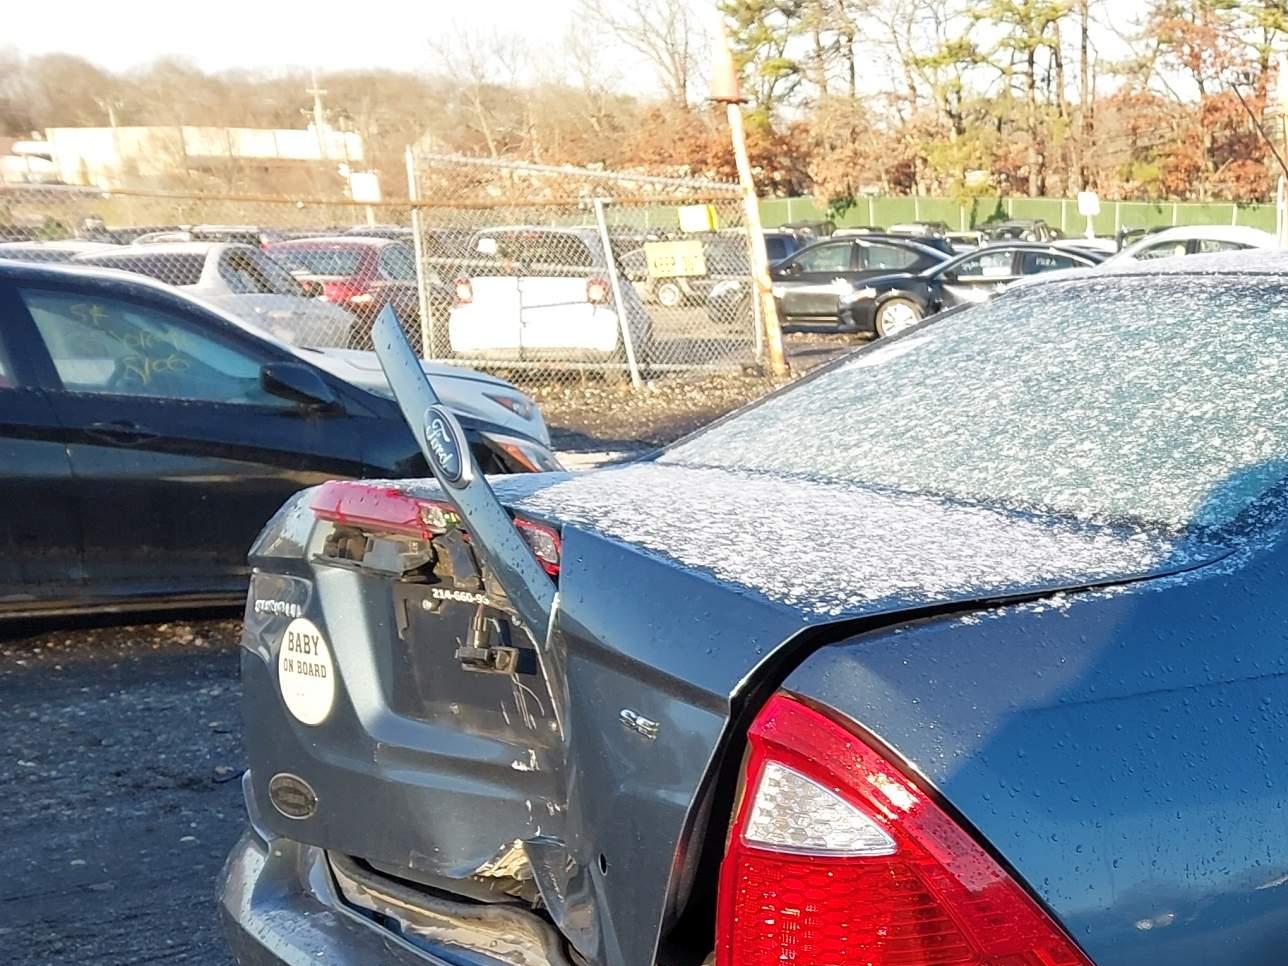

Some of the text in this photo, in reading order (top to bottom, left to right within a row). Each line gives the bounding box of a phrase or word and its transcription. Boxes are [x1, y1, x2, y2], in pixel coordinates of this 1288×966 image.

[426, 418, 453, 470] Ford
[287, 631, 319, 656] BABY
[283, 657, 327, 679] ON BOARD
[619, 708, 661, 740] SE
